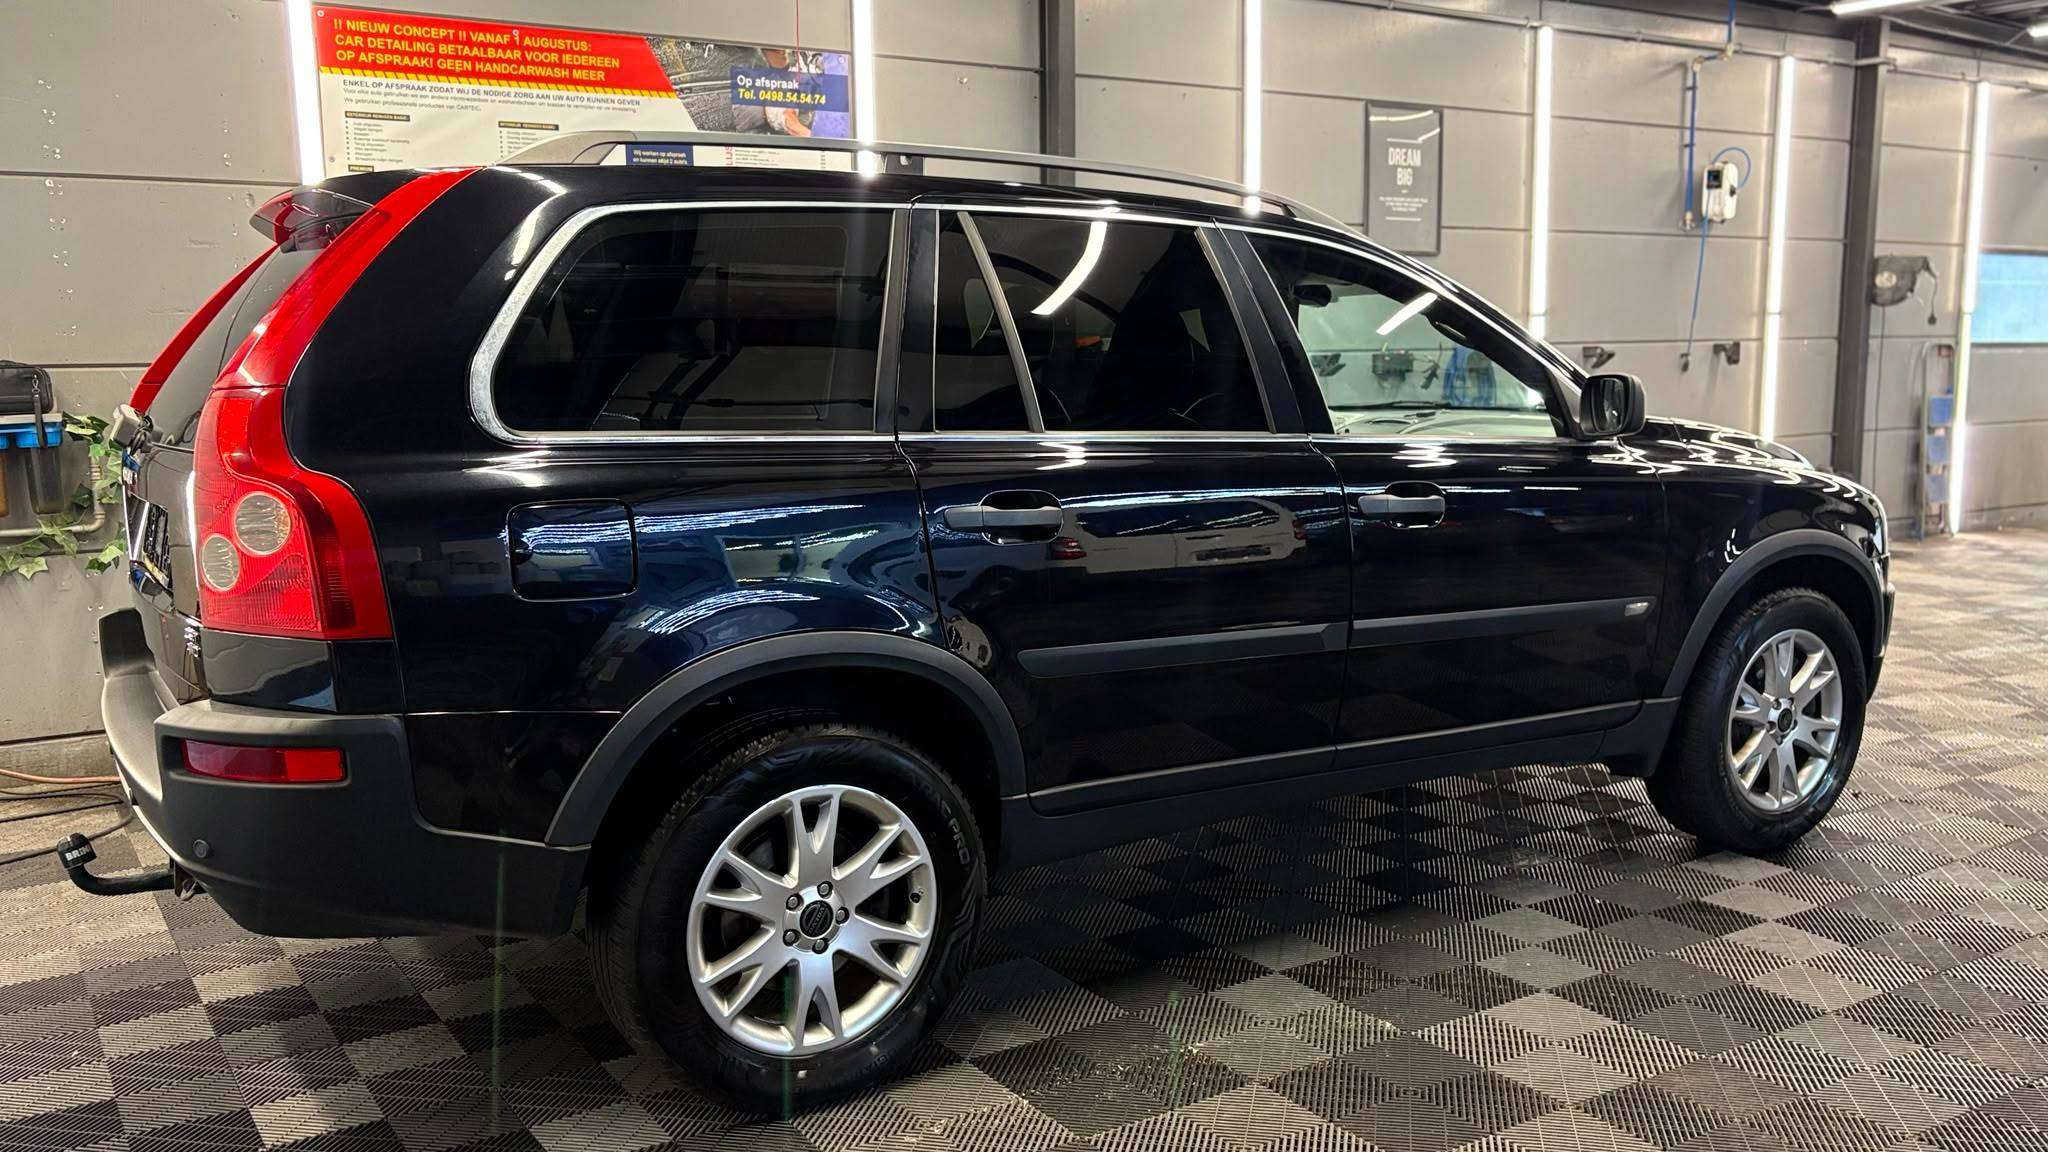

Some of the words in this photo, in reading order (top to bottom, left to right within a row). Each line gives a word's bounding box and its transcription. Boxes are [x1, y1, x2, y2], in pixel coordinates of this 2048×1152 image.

[346, 20, 390, 34] NIEUW
[393, 24, 455, 40] CONCEPT
[469, 31, 511, 45] VANAF
[523, 36, 592, 51] AUGUSTUS:
[335, 34, 364, 47] CAR
[367, 37, 435, 53] DETAILING
[439, 43, 521, 60] BETAALBAAR
[524, 51, 560, 64] VOOR
[562, 54, 620, 68] IEDEREEN
[336, 49, 355, 61] OP
[437, 58, 472, 71] GEEN
[476, 61, 569, 78] HANDCARWASH
[572, 68, 606, 81] MEER
[343, 79, 370, 88] ENKEL
[385, 82, 427, 92] AFSPRAAK
[429, 86, 454, 94] ZODAT
[455, 87, 470, 95] WIJ
[513, 91, 535, 99] ZORG
[586, 97, 616, 105] KUNNEN
[617, 98, 640, 106] GEVEN
[736, 74, 753, 88] Op
[755, 76, 799, 90] afspraak
[738, 89, 756, 99] Tel.
[759, 90, 826, 105] 0498.54.54.74
[1387, 147, 1422, 167] DREAM
[1396, 167, 1413, 186] BIG
